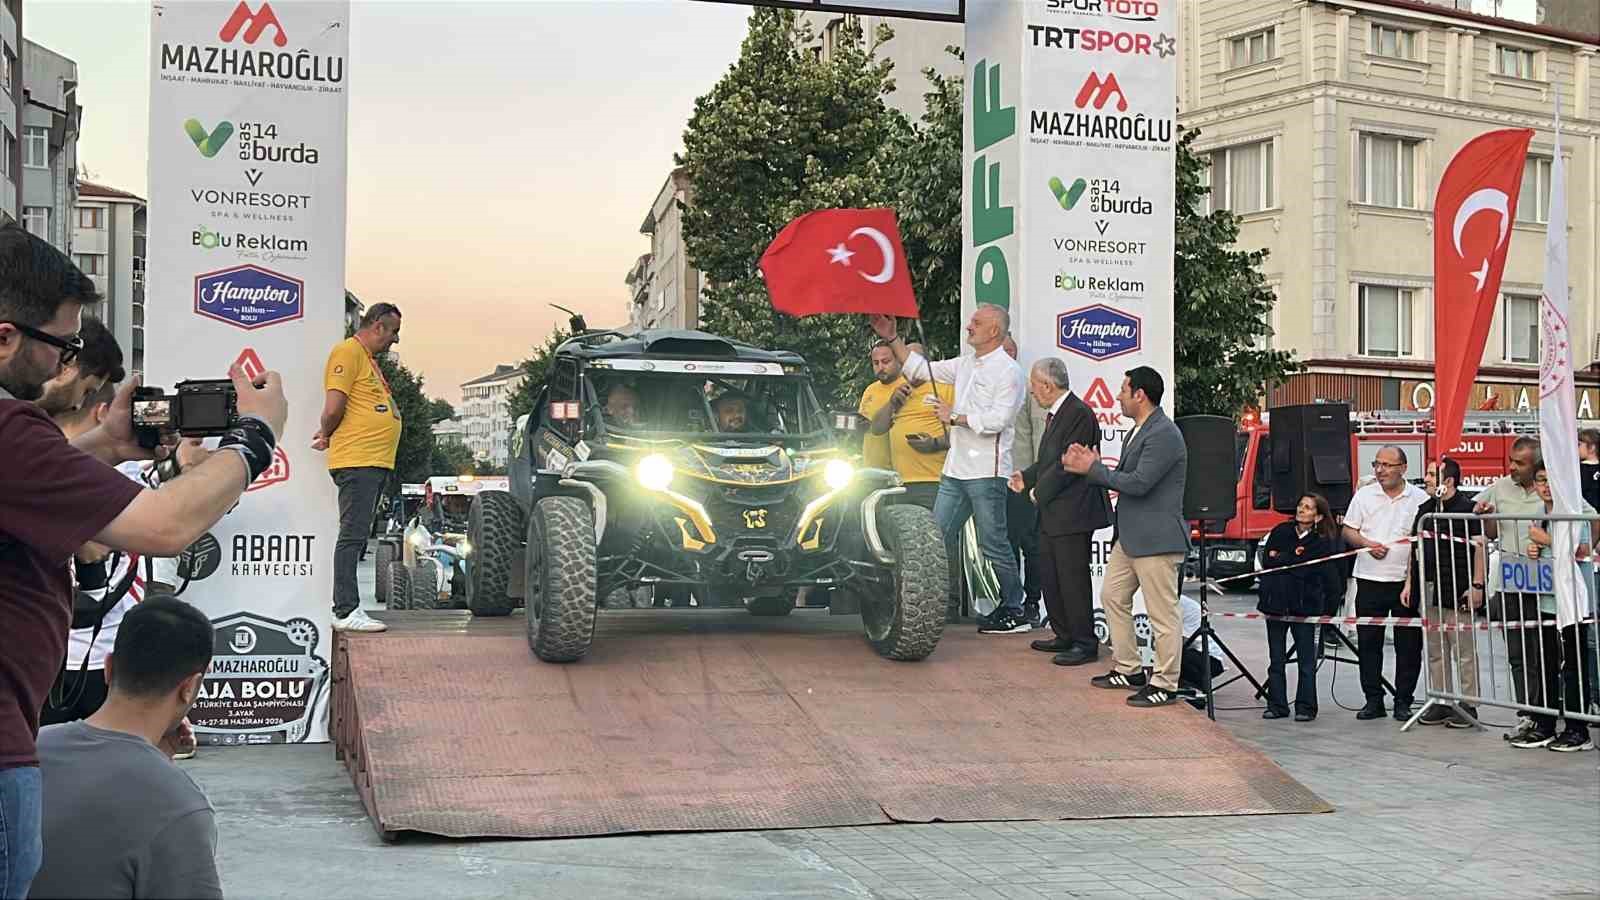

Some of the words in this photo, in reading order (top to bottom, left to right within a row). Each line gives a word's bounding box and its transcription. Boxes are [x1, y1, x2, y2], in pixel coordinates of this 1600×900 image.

[253, 123, 278, 140] 14
[253, 140, 319, 164] burda
[1102, 179, 1121, 194] 14
[191, 189, 311, 209] VONRESORT
[1101, 195, 1153, 215] burda
[236, 233, 308, 251] Reklam
[1054, 238, 1146, 255] VONRESORT
[201, 281, 298, 305] Hampton
[1089, 276, 1144, 292] Reklam
[1062, 318, 1136, 339] Hampton
[1449, 440, 1484, 452] OLU
[232, 535, 315, 562] ABANT
[196, 682, 235, 699] AJA
[241, 681, 305, 699] BOLU
